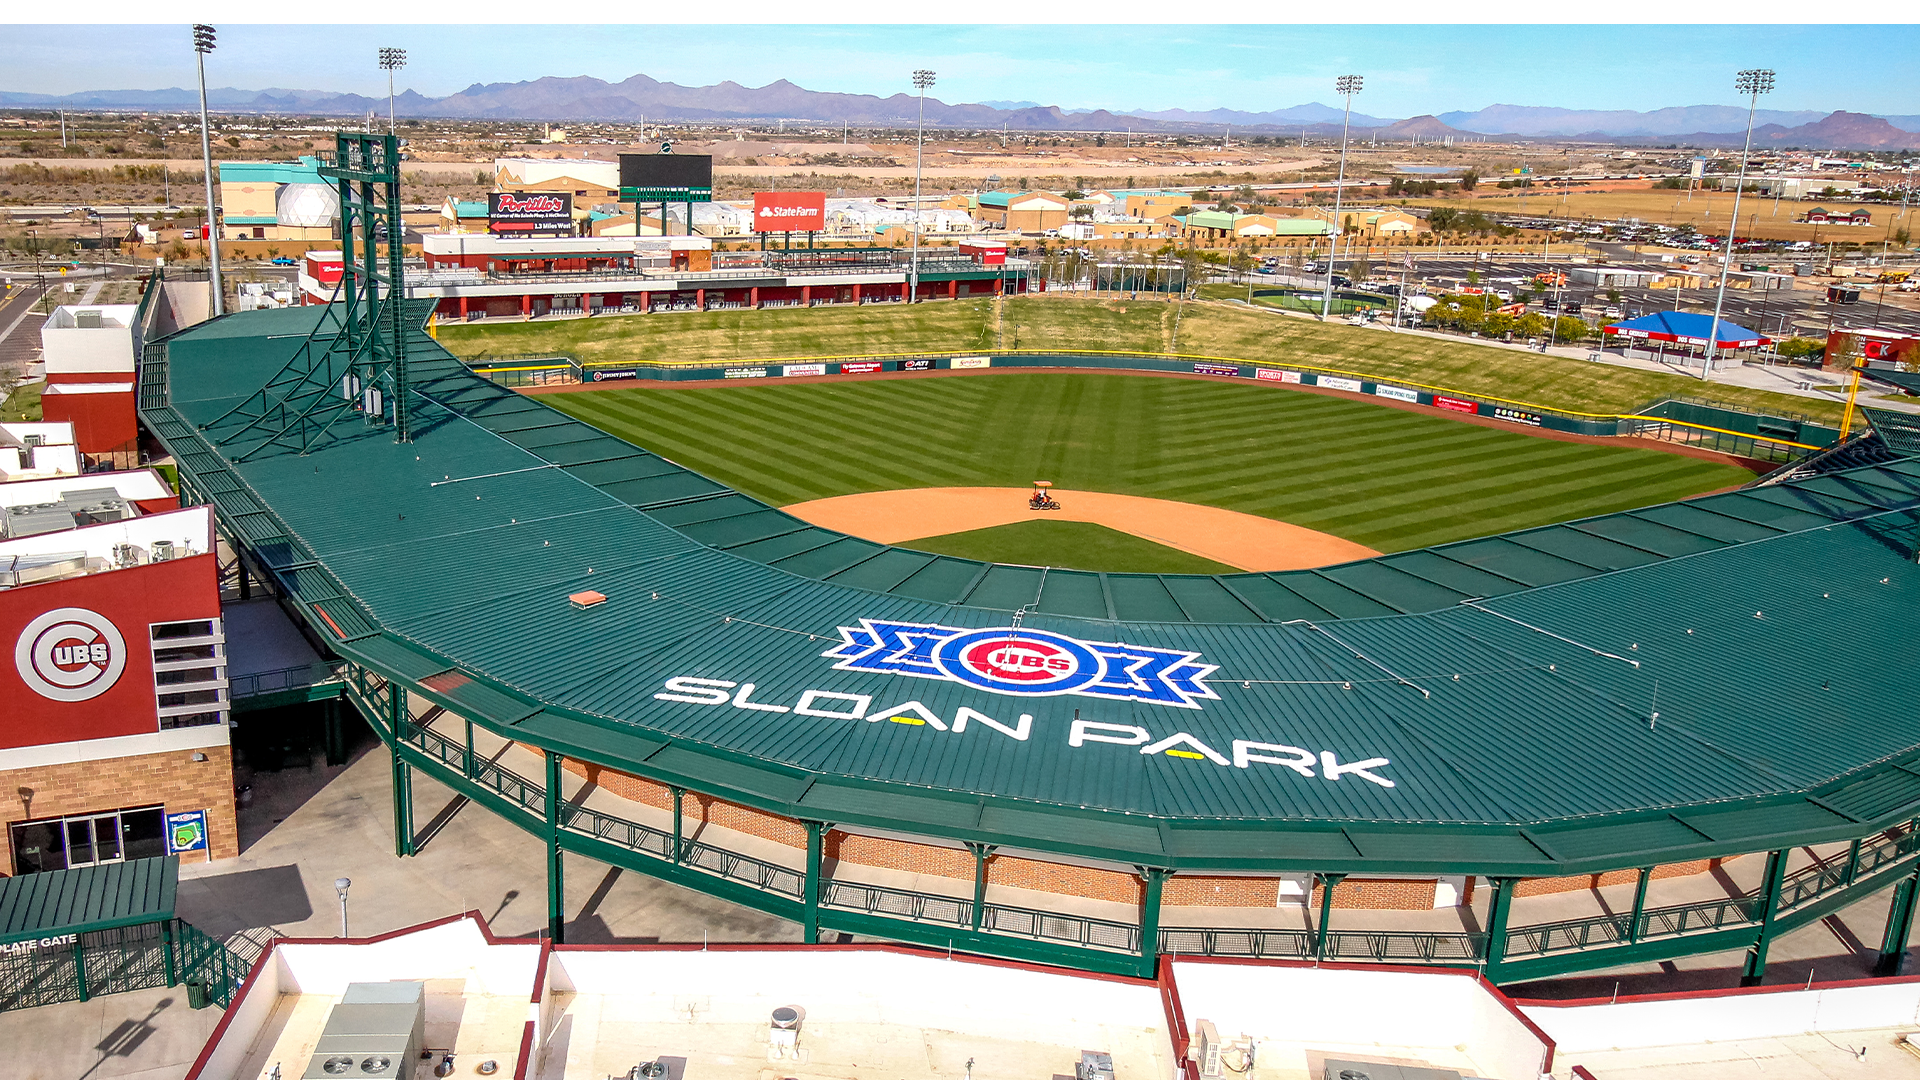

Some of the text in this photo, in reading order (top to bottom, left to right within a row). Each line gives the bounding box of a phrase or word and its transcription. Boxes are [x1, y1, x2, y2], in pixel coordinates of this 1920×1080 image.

[498, 194, 564, 212] Portillo's
[35, 624, 108, 687] CUBS
[967, 640, 1071, 681] CUBS
[653, 674, 1396, 788] SLOAN PARK
[41, 933, 77, 948] GATE
